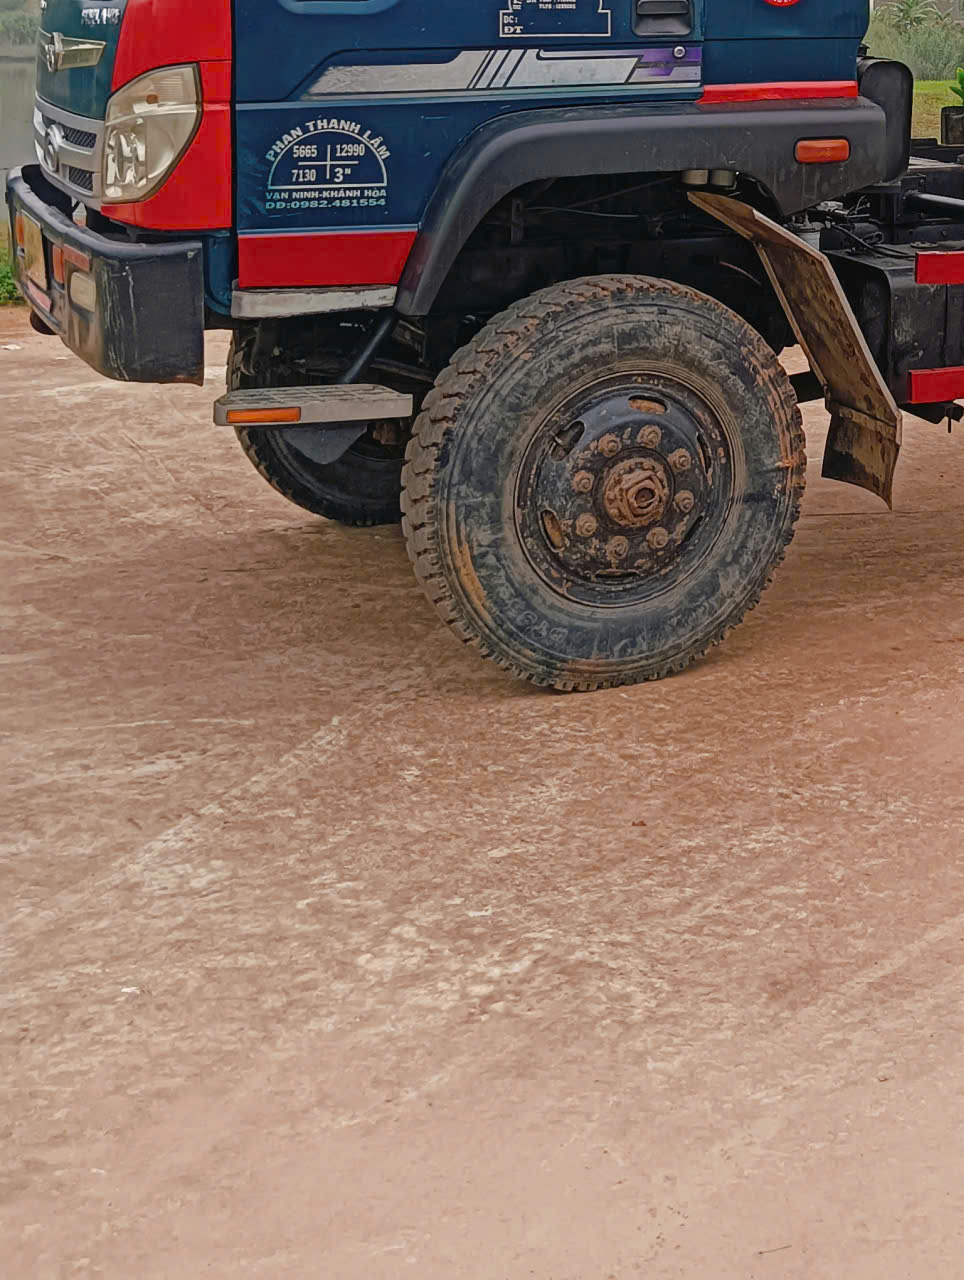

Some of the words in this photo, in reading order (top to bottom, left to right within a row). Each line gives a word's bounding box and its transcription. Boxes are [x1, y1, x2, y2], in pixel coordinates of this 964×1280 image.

[265, 126, 303, 162] PHAN
[304, 118, 361, 134] THANH
[292, 144, 318, 158] 5665
[335, 143, 366, 157] 12990
[291, 168, 317, 182] 7130
